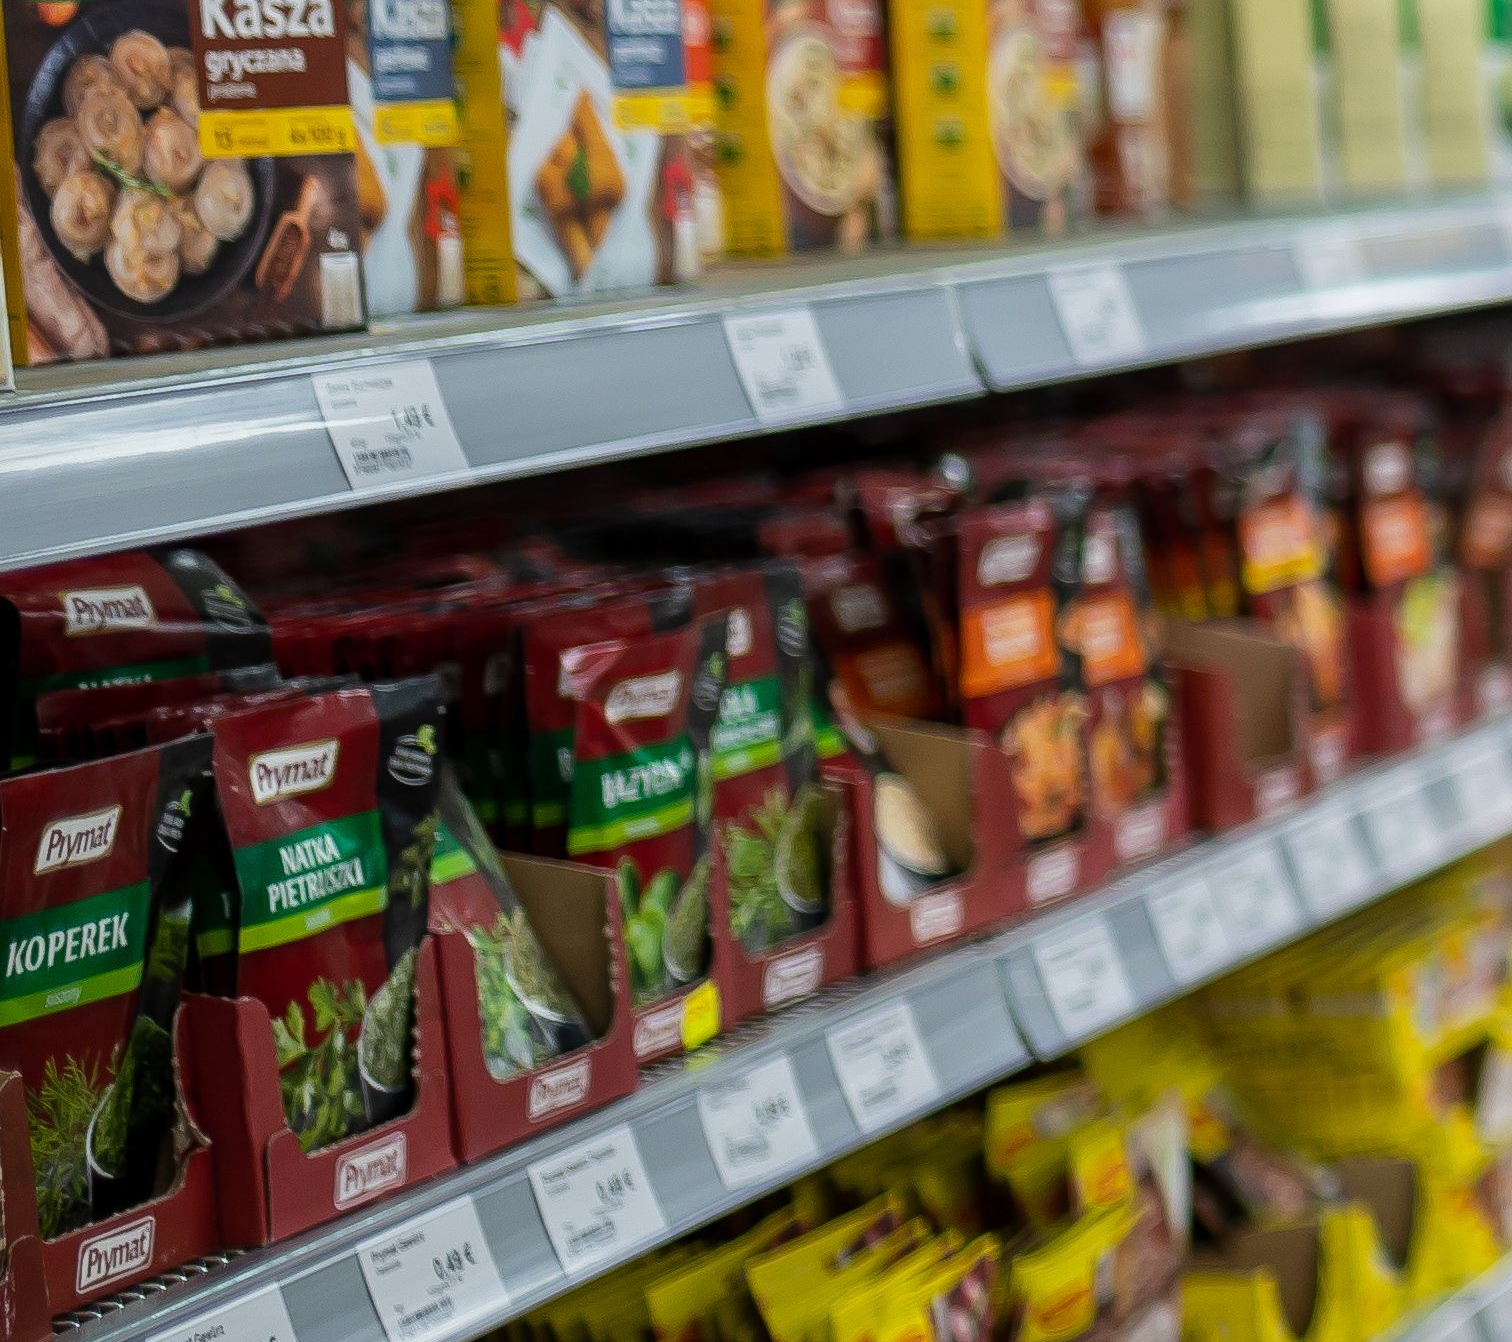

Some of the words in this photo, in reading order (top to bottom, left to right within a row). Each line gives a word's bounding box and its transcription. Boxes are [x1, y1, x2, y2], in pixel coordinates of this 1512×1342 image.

[72, 594, 149, 626] Prymat
[256, 752, 329, 795] Prymat
[45, 821, 113, 864] Prymat
[278, 834, 341, 876] NATKA
[267, 857, 366, 914] PIETRUSZKI
[5, 912, 129, 978] KOPEREK
[345, 1149, 400, 1194] Prymat
[86, 1232, 148, 1281] Prymat
